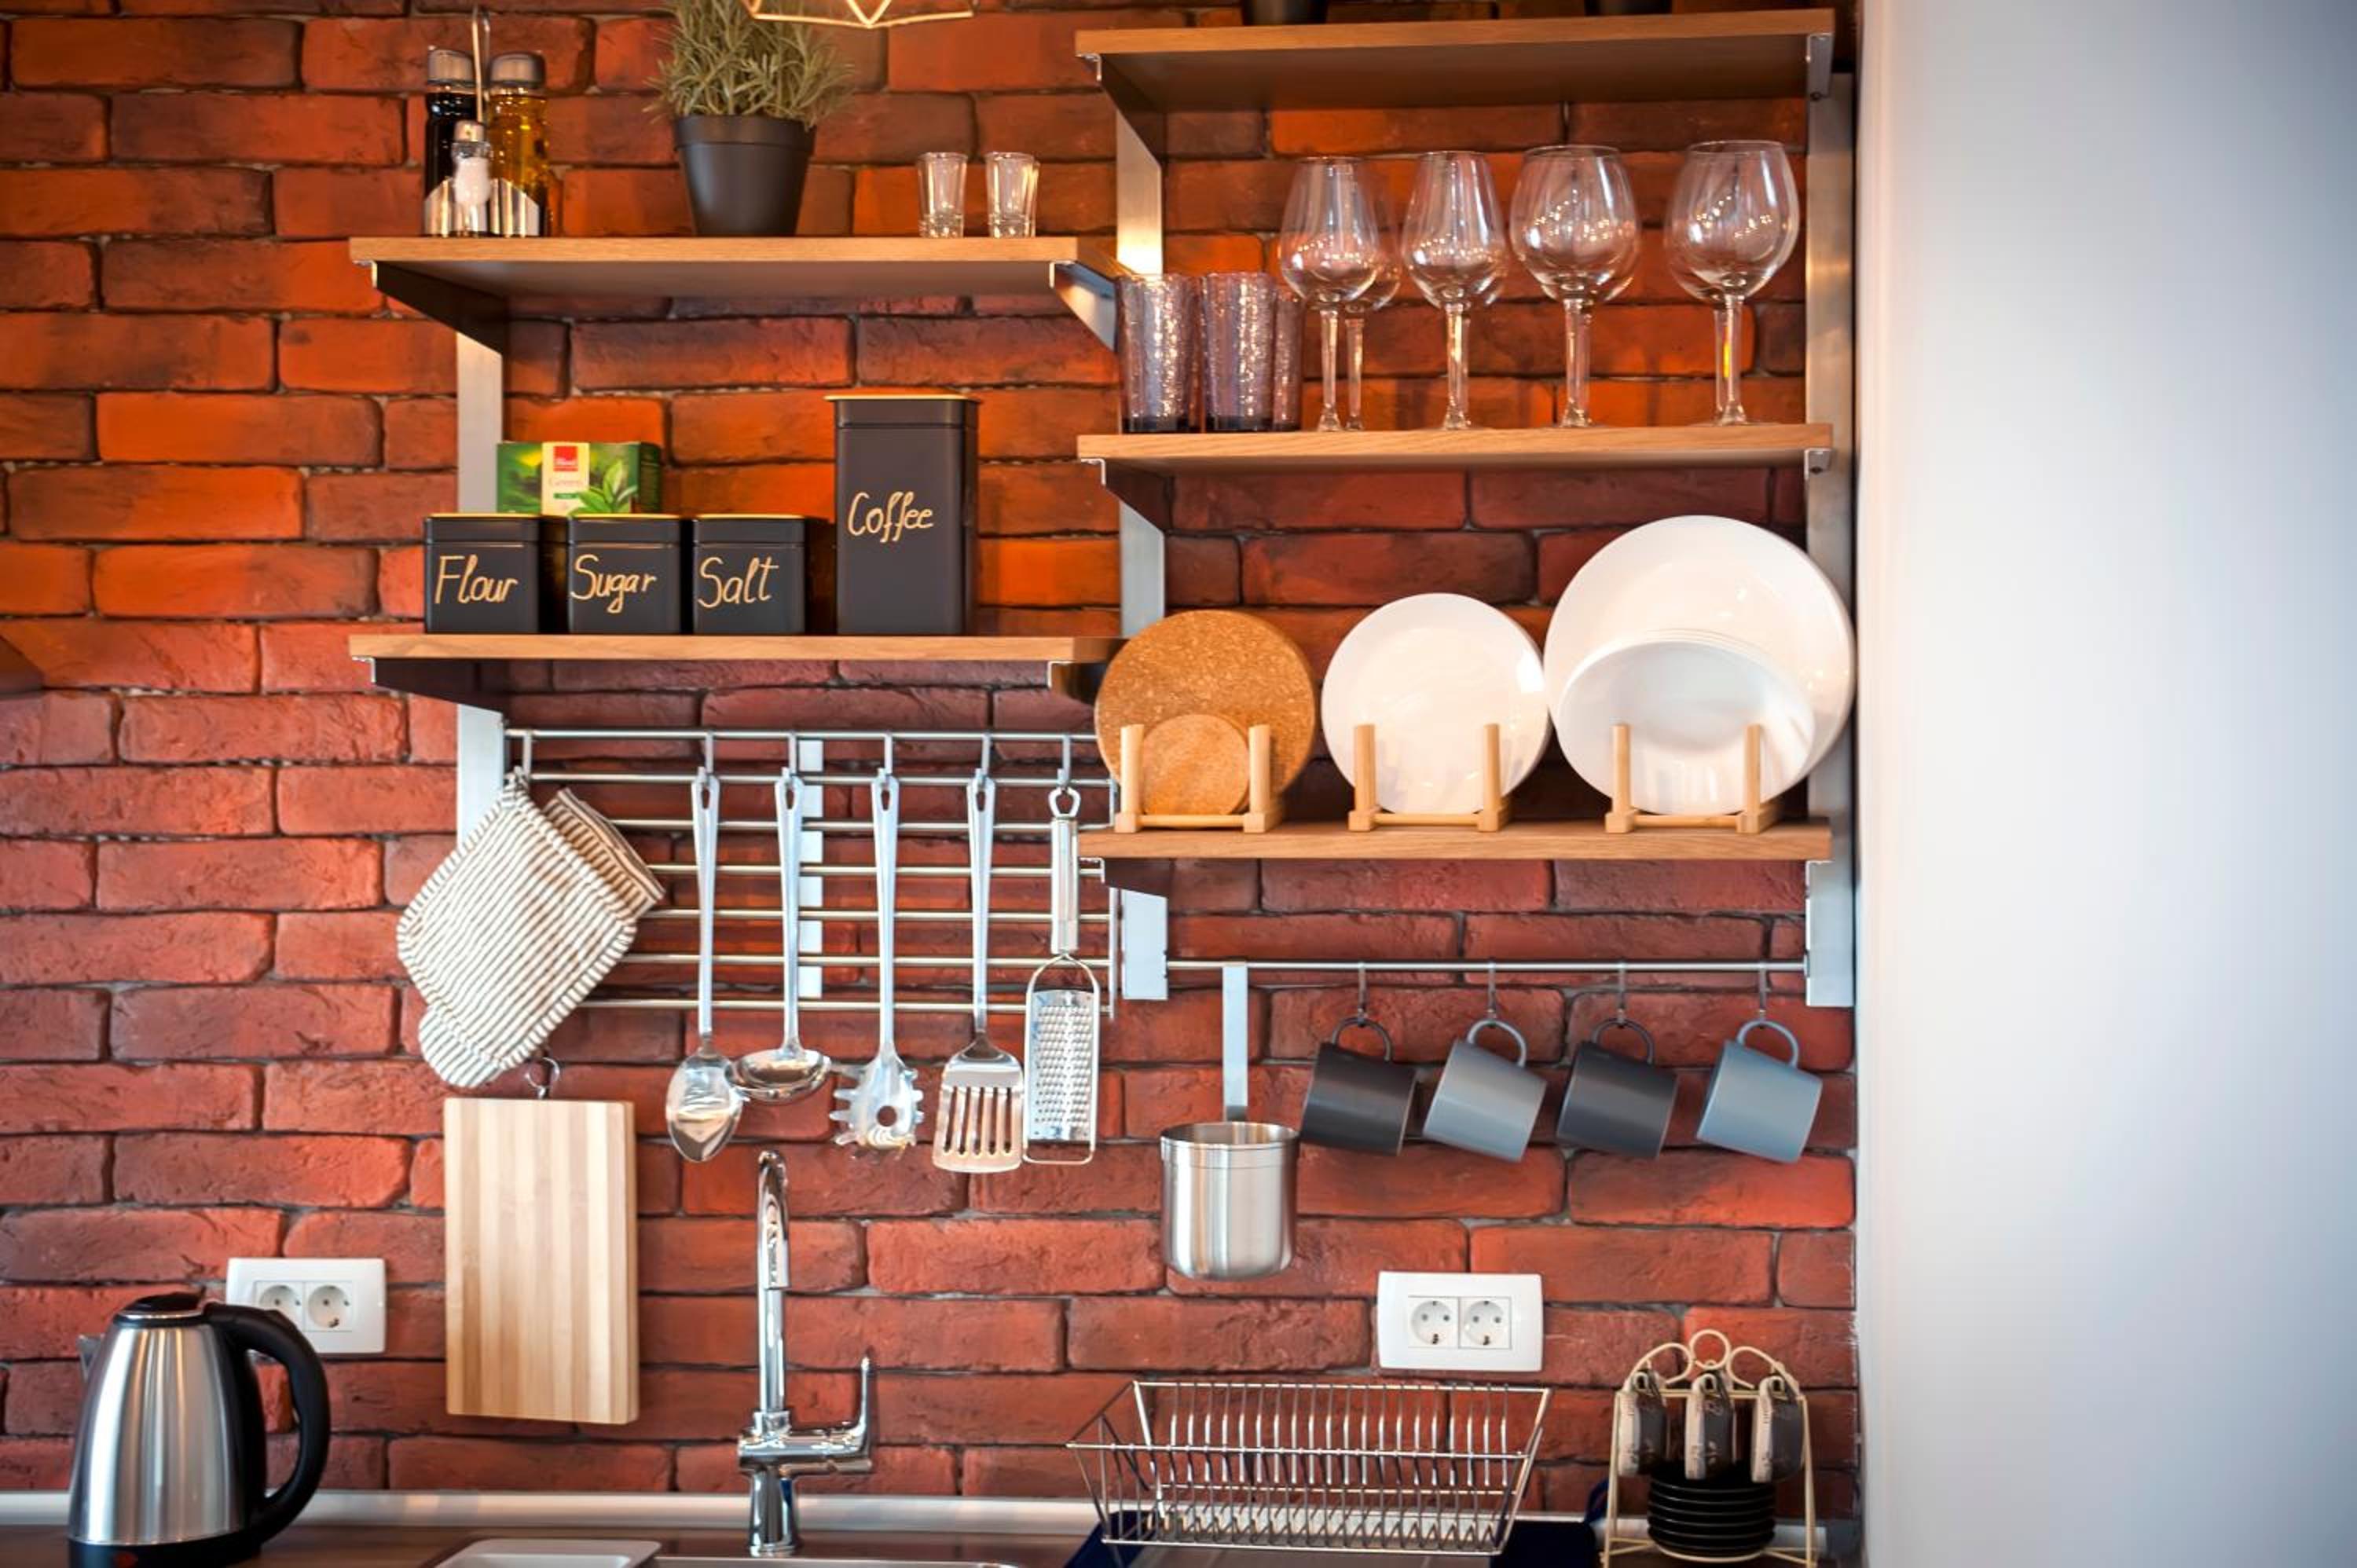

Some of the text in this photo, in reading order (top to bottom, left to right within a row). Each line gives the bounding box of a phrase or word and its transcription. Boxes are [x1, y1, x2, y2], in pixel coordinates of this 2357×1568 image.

[847, 491, 934, 543] Coffee
[434, 554, 519, 604] Flour
[570, 554, 658, 614] Sugar
[697, 556, 780, 608] Salt
